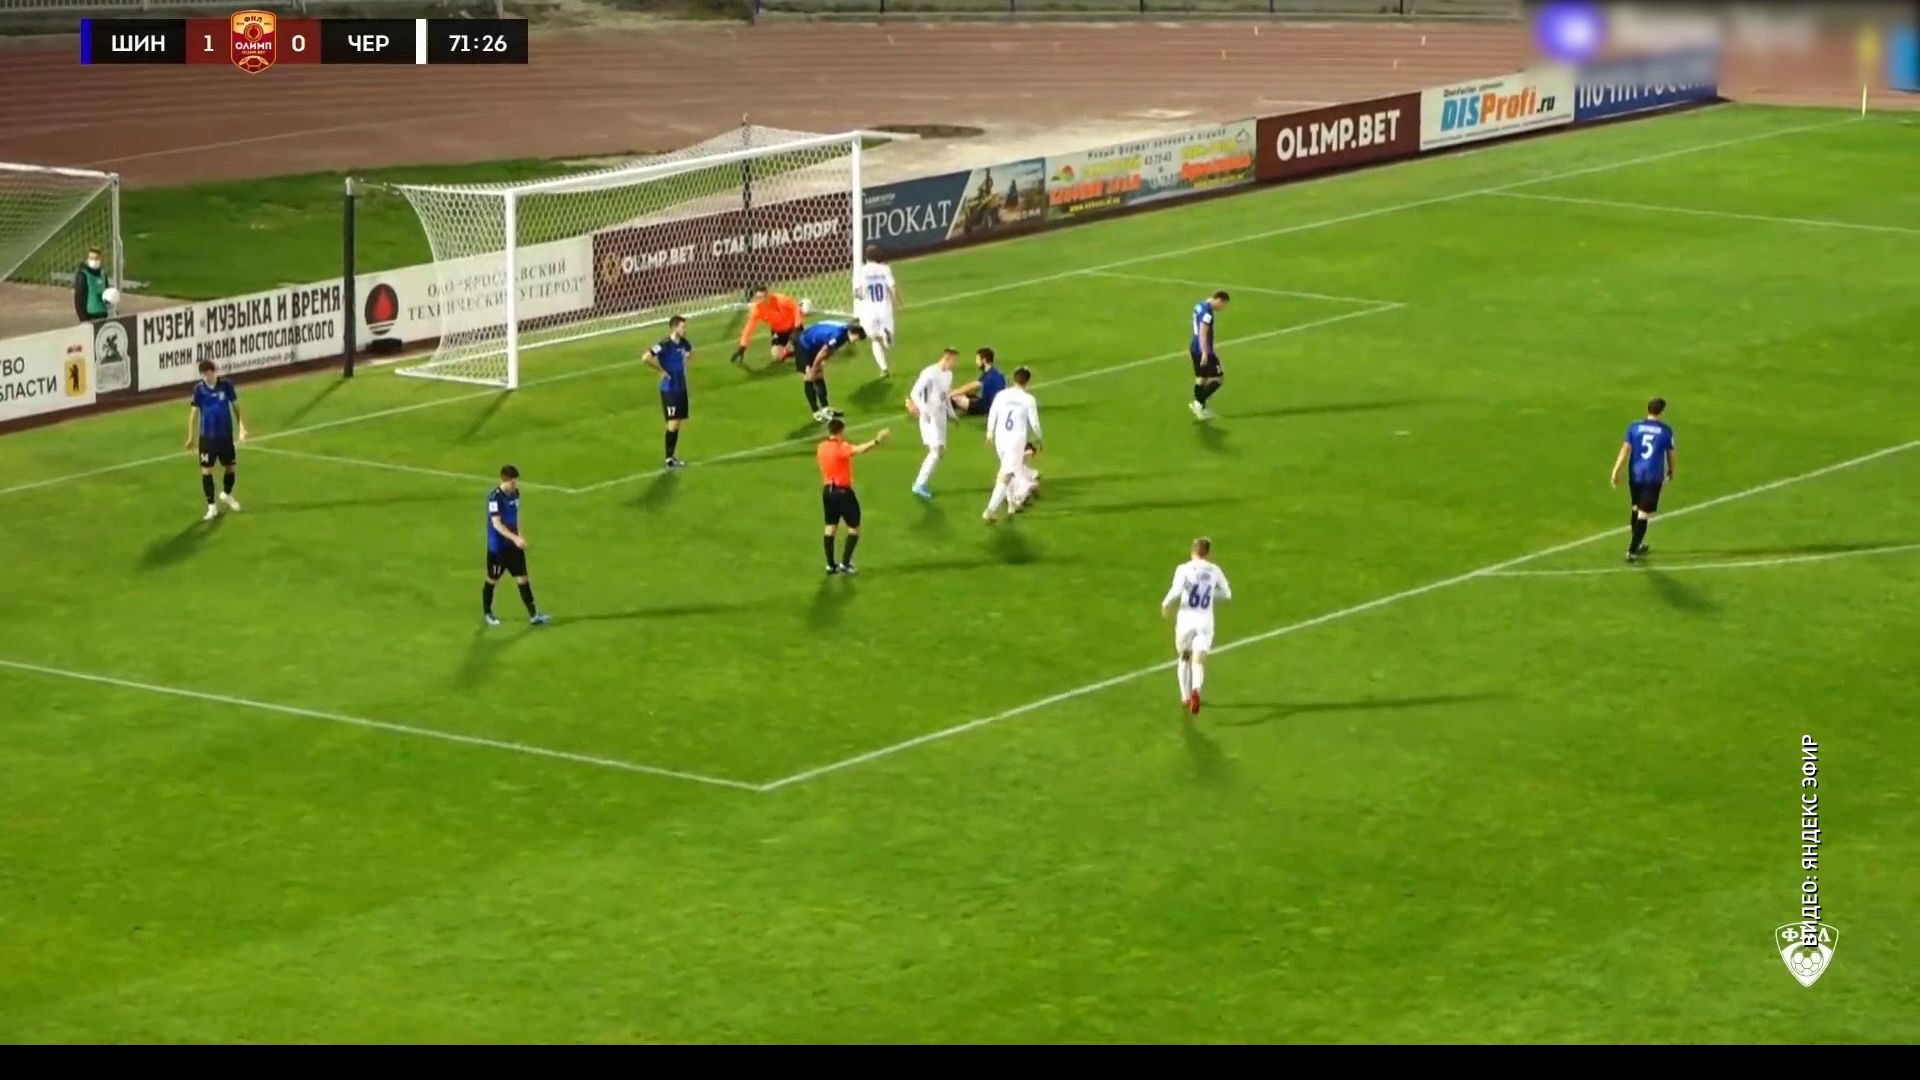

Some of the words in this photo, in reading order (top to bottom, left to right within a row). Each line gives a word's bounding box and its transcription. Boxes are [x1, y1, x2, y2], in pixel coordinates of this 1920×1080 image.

[1276, 108, 1400, 161] OLIMP.BET
[862, 199, 952, 241] ПРОКАТ
[867, 282, 884, 303] 10
[143, 306, 194, 346] МУЗЕЙ
[278, 293, 287, 322] И
[196, 336, 237, 364] ДЖОНА
[240, 319, 335, 354] МОСТОСЛАВСКОГО
[0, 356, 26, 377] ВО
[1004, 409, 1014, 431] 6
[1640, 433, 1654, 460] 5
[1188, 583, 1212, 610] 66
